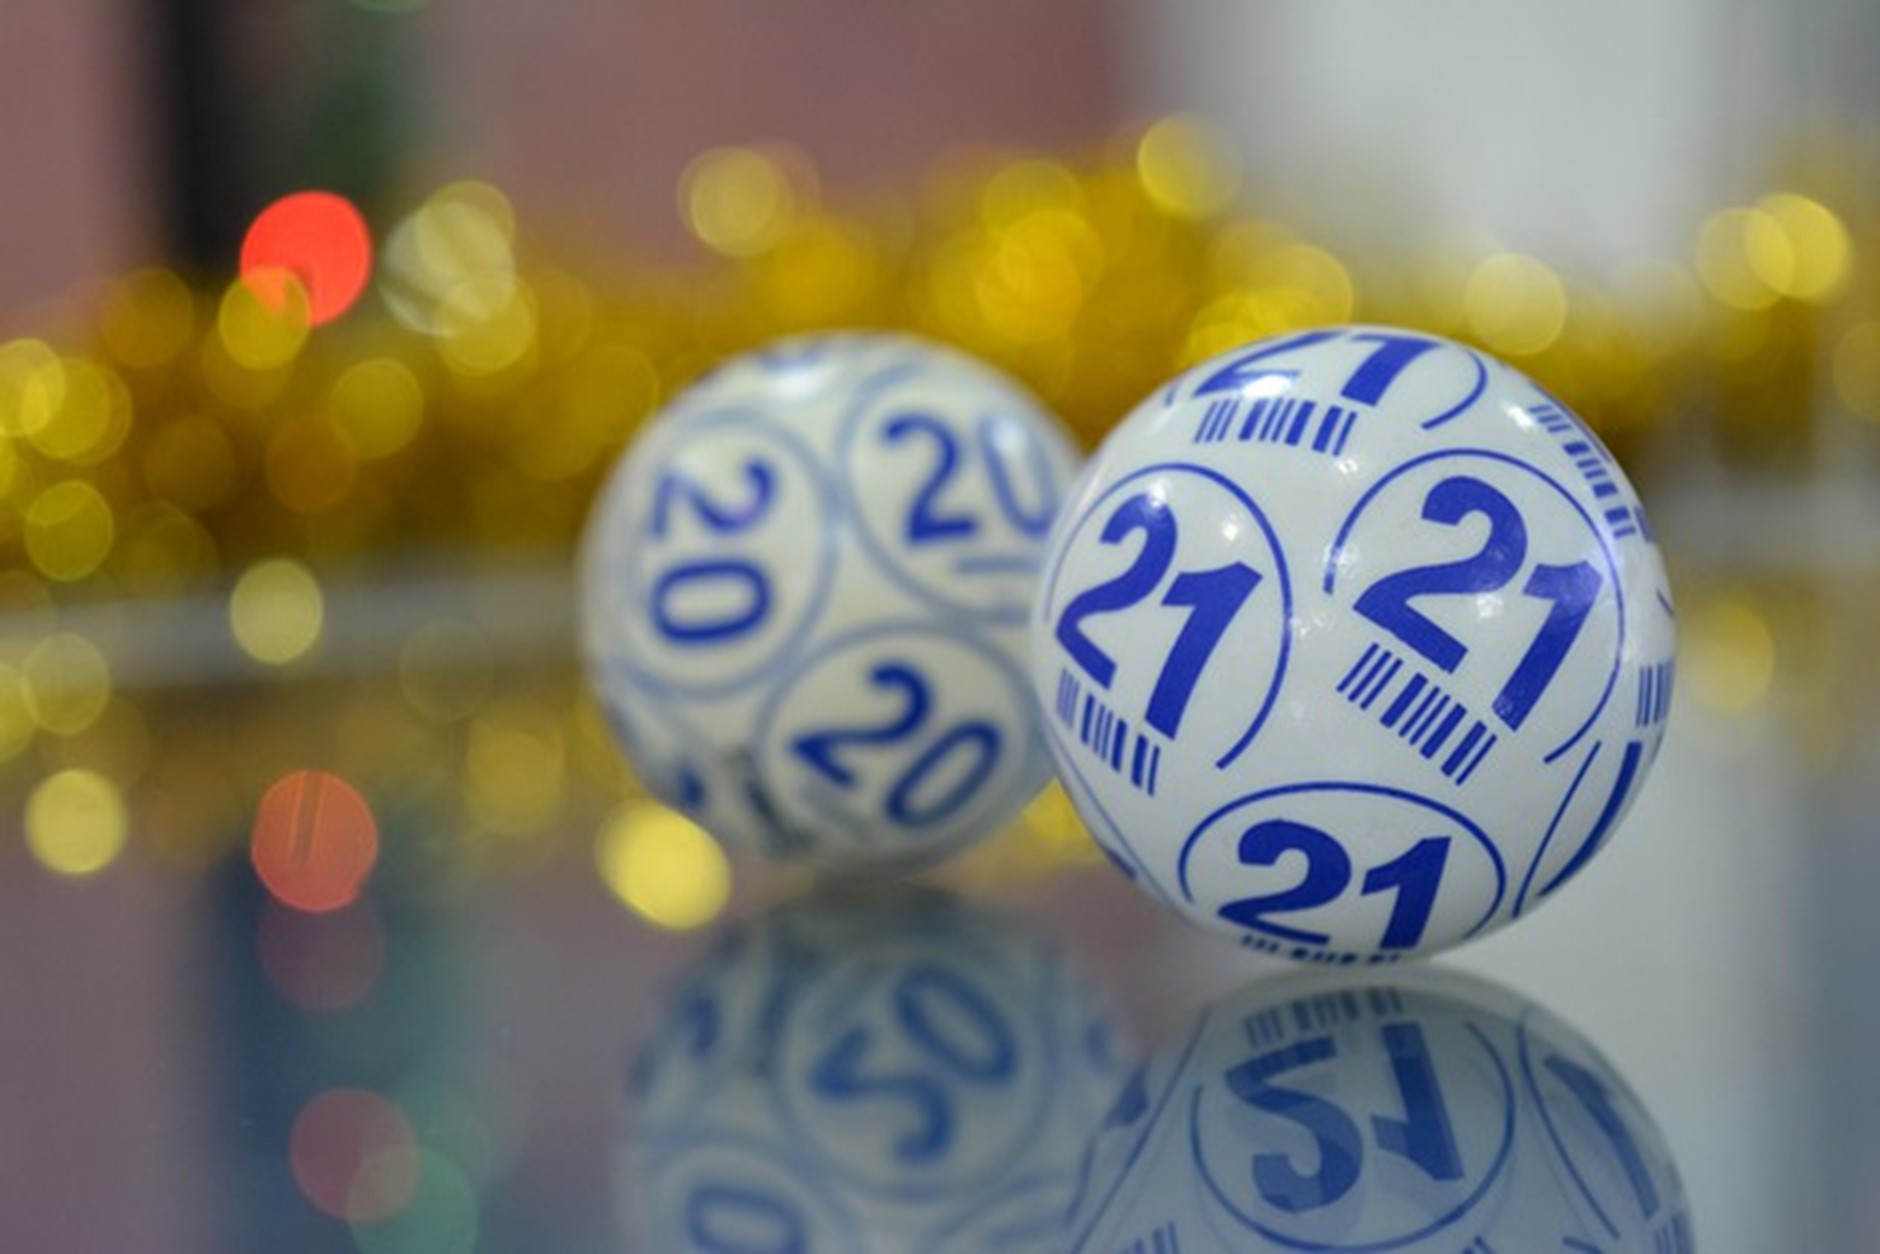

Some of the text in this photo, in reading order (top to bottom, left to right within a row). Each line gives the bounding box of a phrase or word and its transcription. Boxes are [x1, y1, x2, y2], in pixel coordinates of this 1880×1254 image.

[651, 456, 778, 646] 20
[881, 412, 1057, 543] 20
[1055, 493, 1263, 741] 21
[1352, 475, 1603, 733] 21
[792, 659, 1001, 830] 20
[1216, 818, 1452, 950] 21
